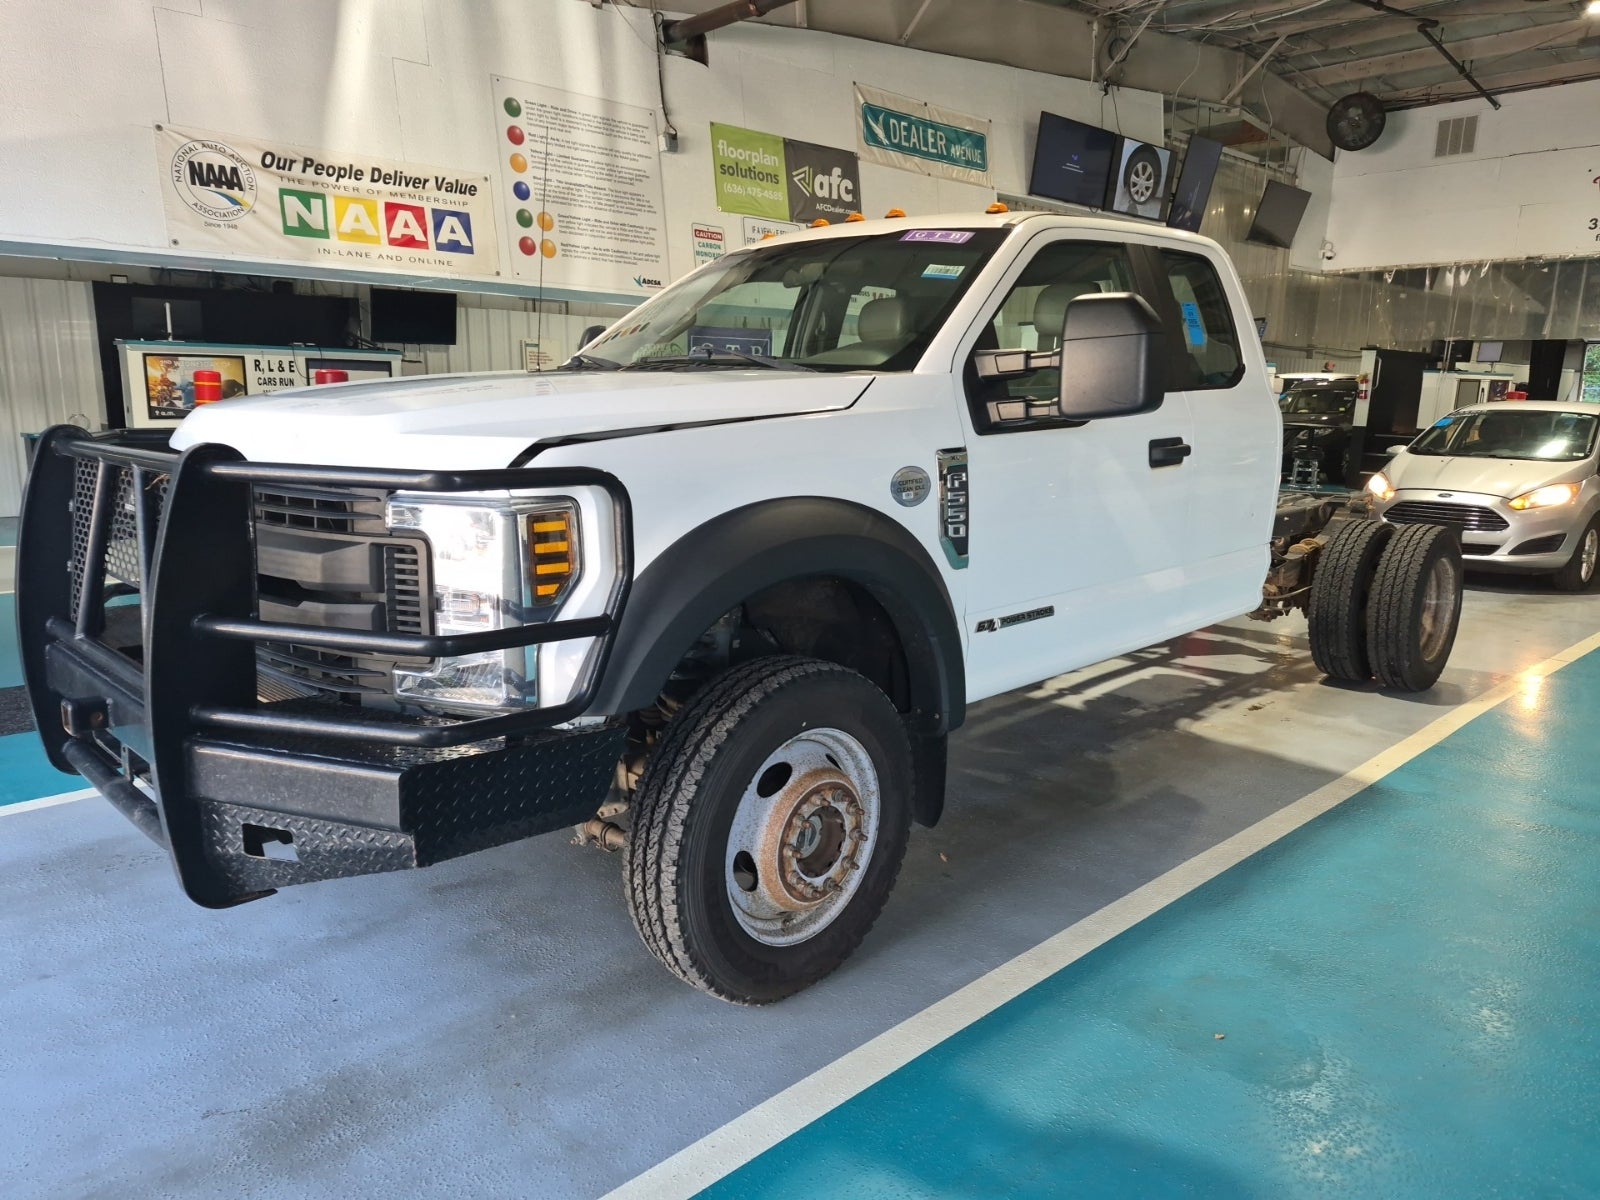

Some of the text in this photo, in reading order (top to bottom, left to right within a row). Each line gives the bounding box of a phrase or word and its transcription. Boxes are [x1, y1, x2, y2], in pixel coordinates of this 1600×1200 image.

[889, 118, 982, 163] DEALER AVENUE
[717, 139, 779, 166] floorplan
[174, 142, 255, 191] NATIONAL AUTO AUCTION
[187, 160, 245, 192] NAAA
[260, 151, 478, 197] Our People Deliver Value
[720, 162, 780, 185] solutions
[279, 175, 305, 185] THE
[311, 181, 361, 193] POWER
[389, 191, 469, 207] MEMBERSHIP
[814, 167, 853, 202] afc
[192, 202, 245, 218] ASSOCIATION
[695, 231, 722, 240] CAUTION
[698, 241, 722, 250] CARBON
[317, 247, 454, 267] IN-LANE AND ONLINE
[695, 250, 723, 258] MONOXID
[254, 359, 295, 374] R, L & E
[257, 376, 295, 387] CARS RUN
[896, 486, 914, 494] CLEAN
